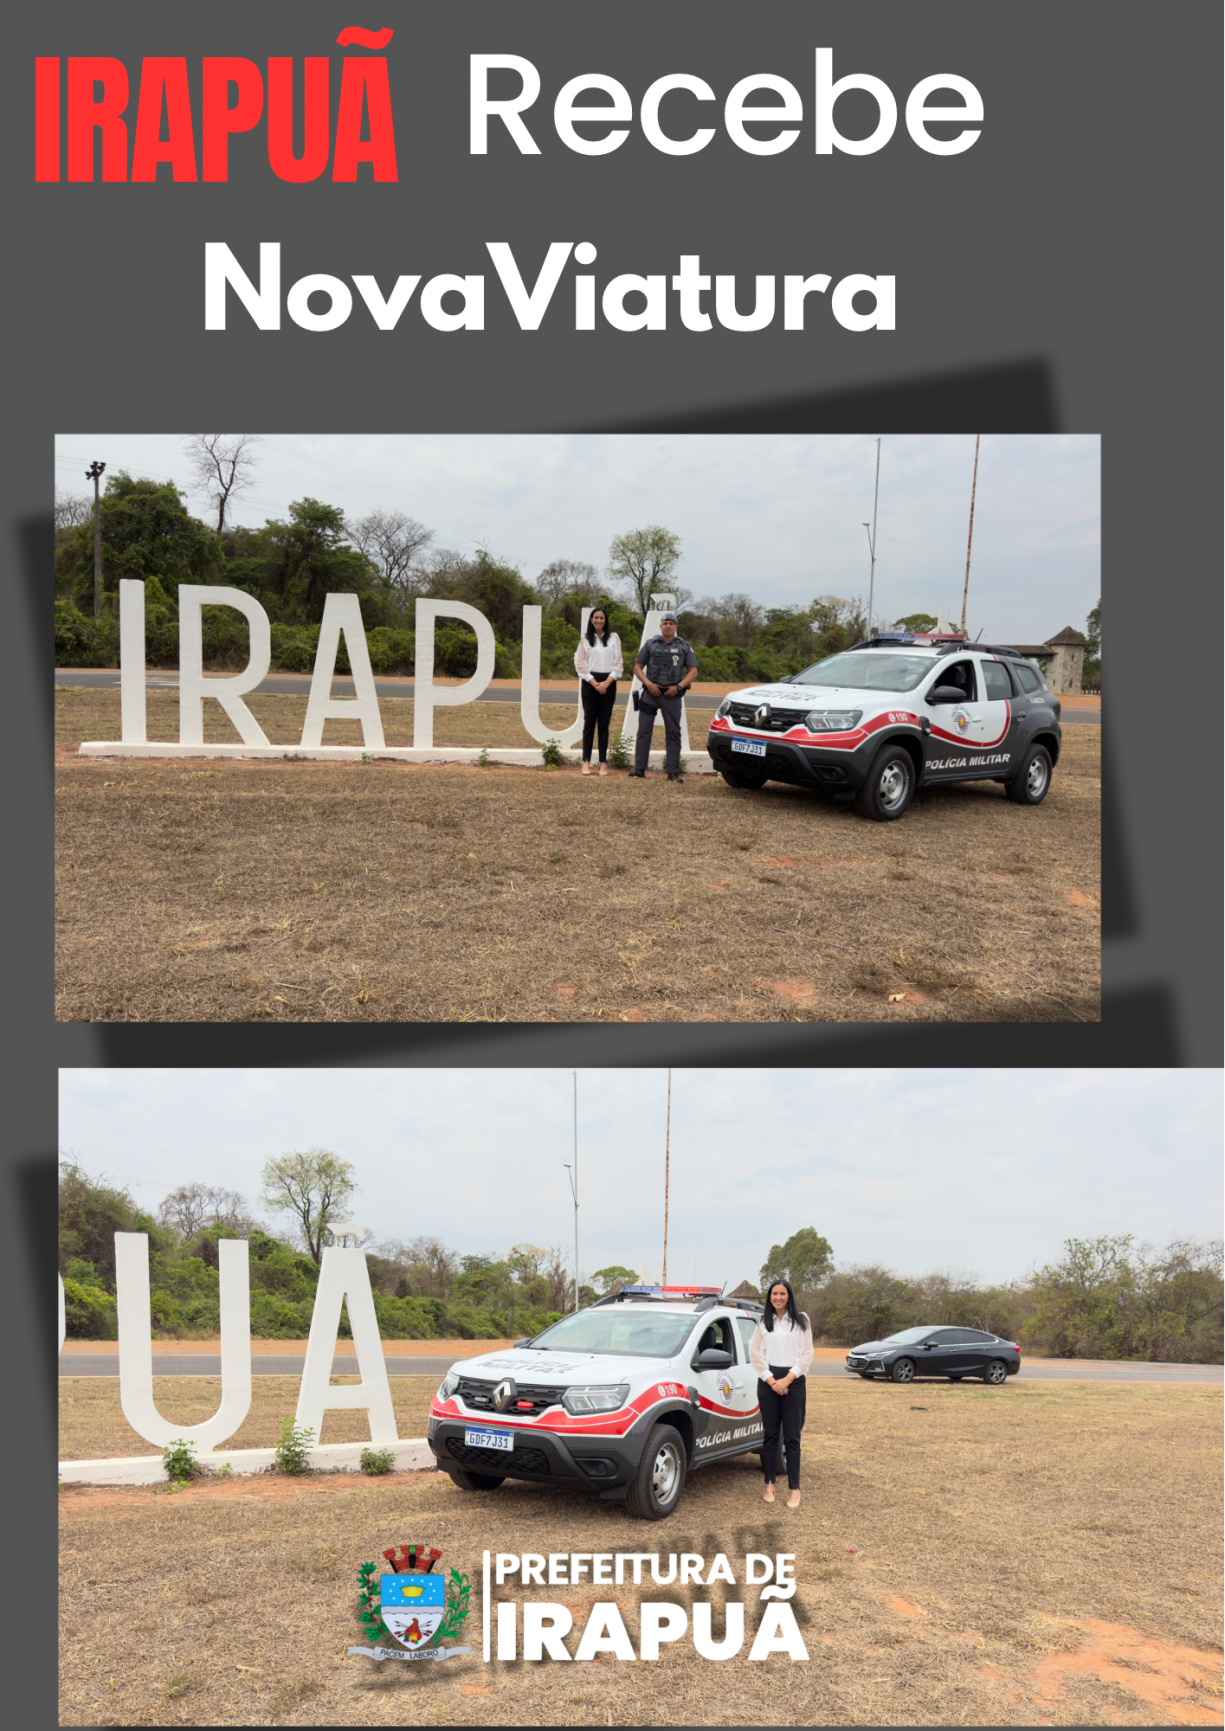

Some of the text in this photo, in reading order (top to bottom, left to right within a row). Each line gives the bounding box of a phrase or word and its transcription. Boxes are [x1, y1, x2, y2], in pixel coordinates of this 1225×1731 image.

[895, 712, 909, 722] 190
[734, 742, 763, 755] GDF7J31
[925, 753, 1011, 770] POLÍCIA MILITAR
[665, 1383, 678, 1395] 190
[469, 1432, 509, 1449] GDF7J31
